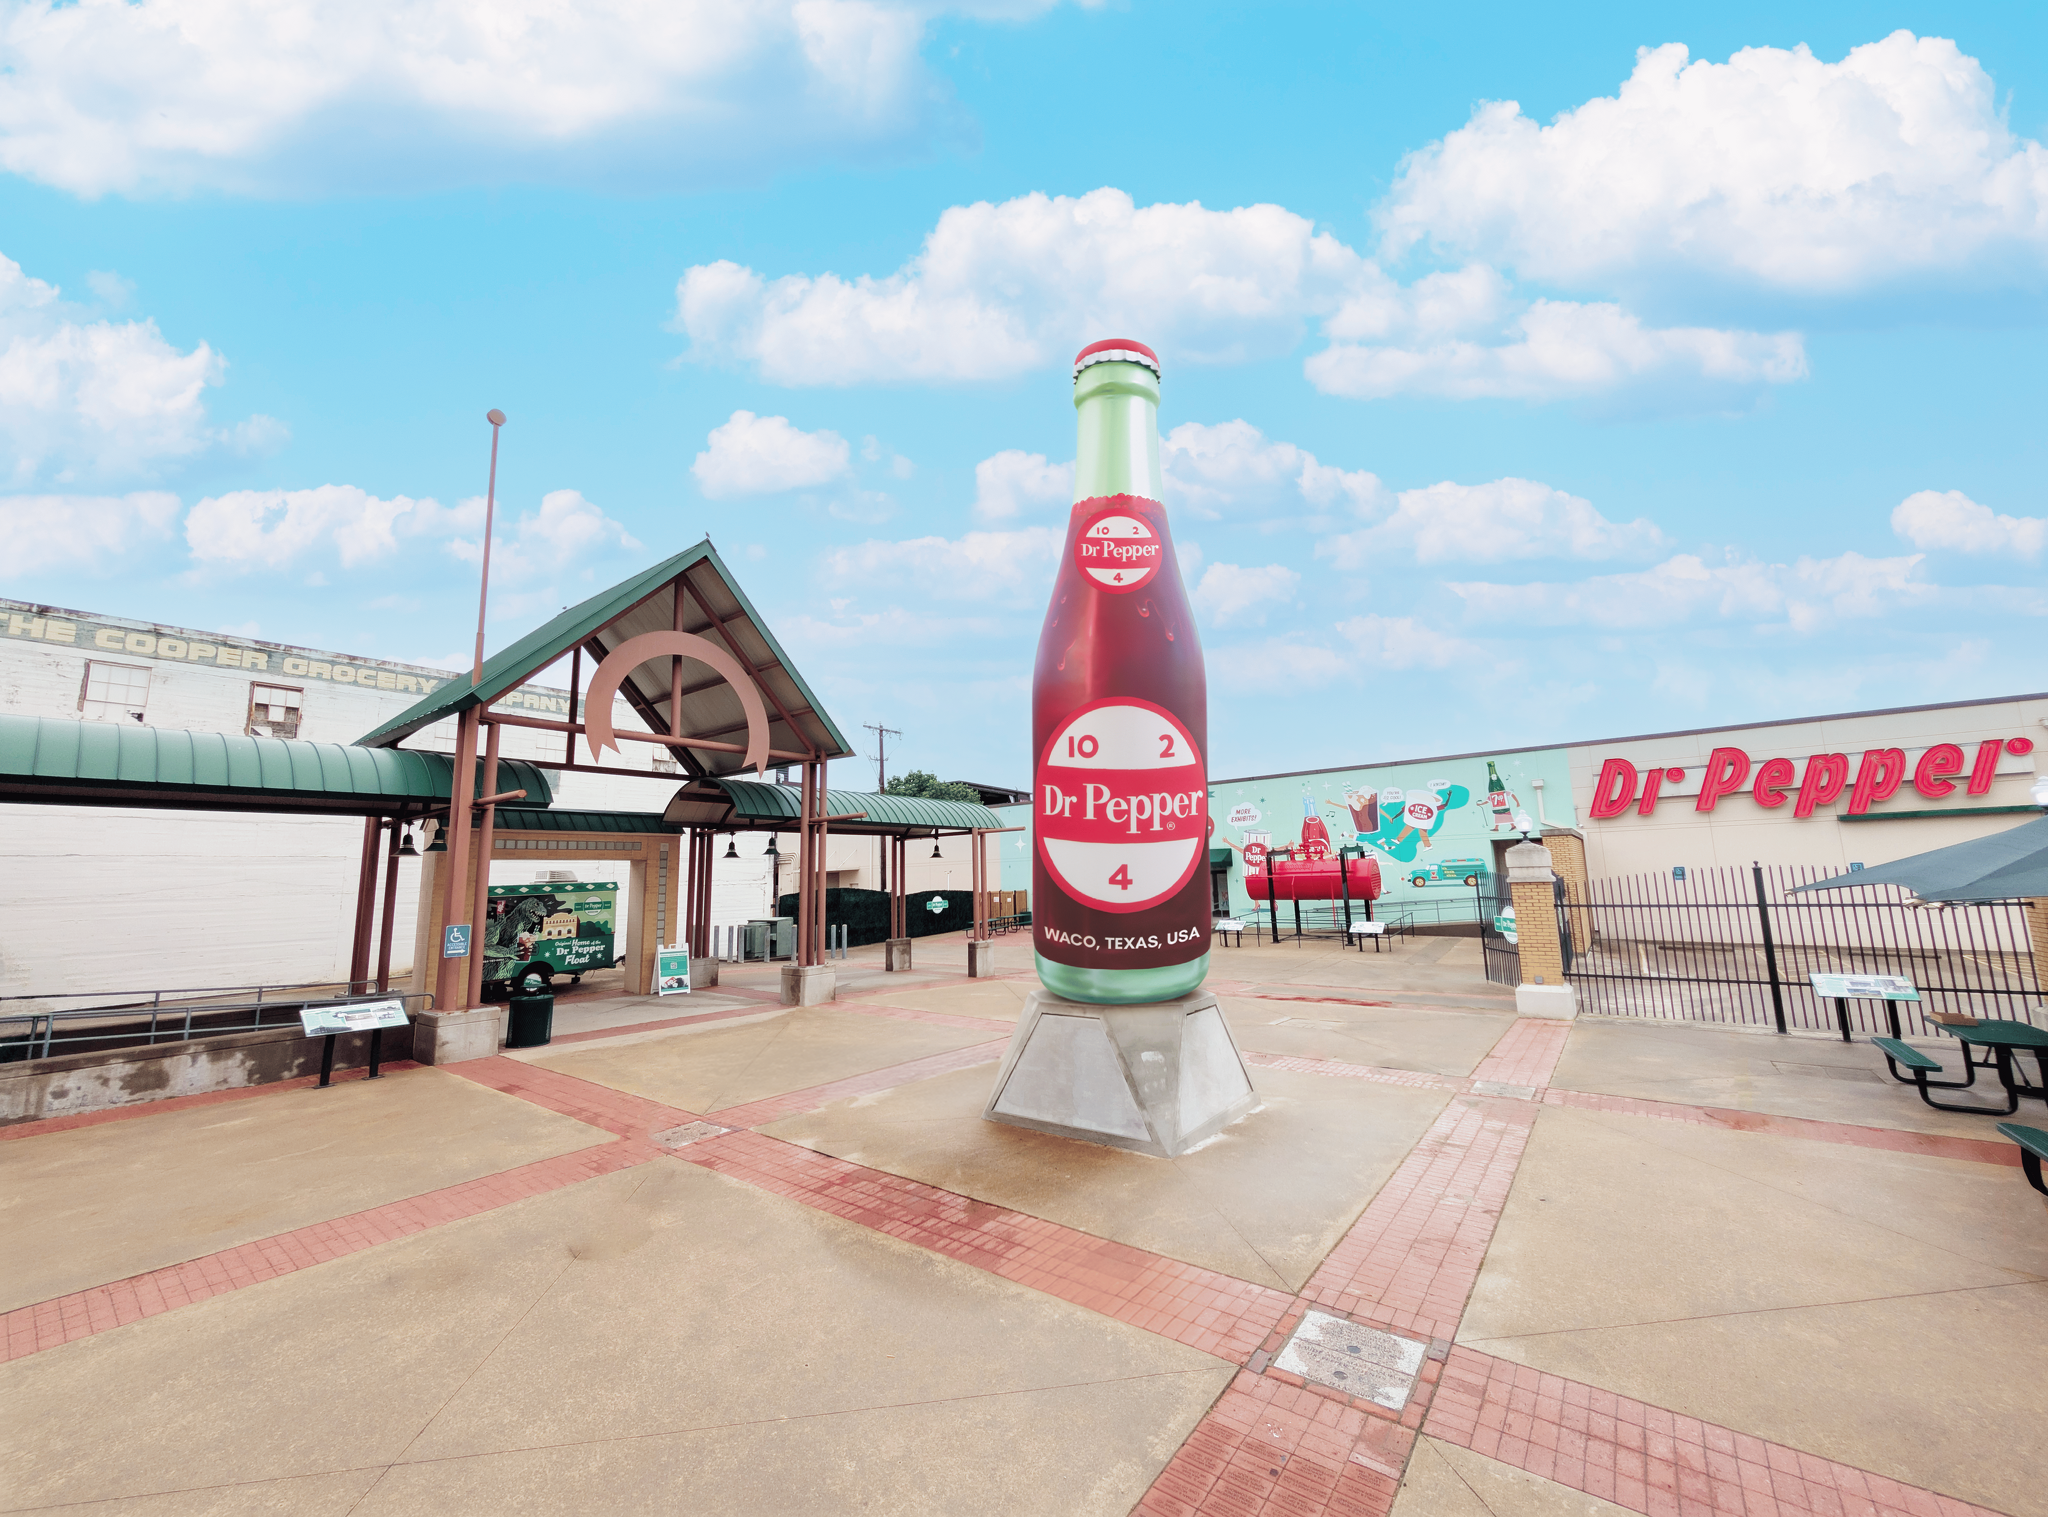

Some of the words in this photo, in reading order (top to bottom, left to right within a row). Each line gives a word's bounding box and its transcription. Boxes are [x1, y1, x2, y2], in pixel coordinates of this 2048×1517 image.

[1097, 526, 1110, 535] 10
[1132, 526, 1140, 535] 2
[1081, 544, 1100, 556] Dr
[1101, 540, 1159, 562] Pepper
[1113, 572, 1124, 583] 4
[95, 628, 268, 671] COOPER
[283, 657, 438, 694] GROCERY
[1068, 734, 1099, 759] 10
[1158, 733, 1175, 759] 2
[1589, 757, 1686, 819] Dr
[1695, 736, 2035, 819] Pepper
[1042, 784, 1078, 817] Dr
[1083, 783, 1203, 834] Pepper
[1414, 805, 1428, 814] ICE
[1252, 846, 1261, 854] Dr
[1245, 853, 1266, 864] Peppe
[1108, 863, 1134, 890] 4
[572, 938, 590, 946] Home
[1044, 926, 1100, 951] WACO,
[1105, 934, 1163, 950] TEXAS,
[1167, 926, 1200, 946] USA
[556, 948, 570, 956] Dr
[572, 944, 606, 954] Pepper
[564, 954, 590, 966] Float
